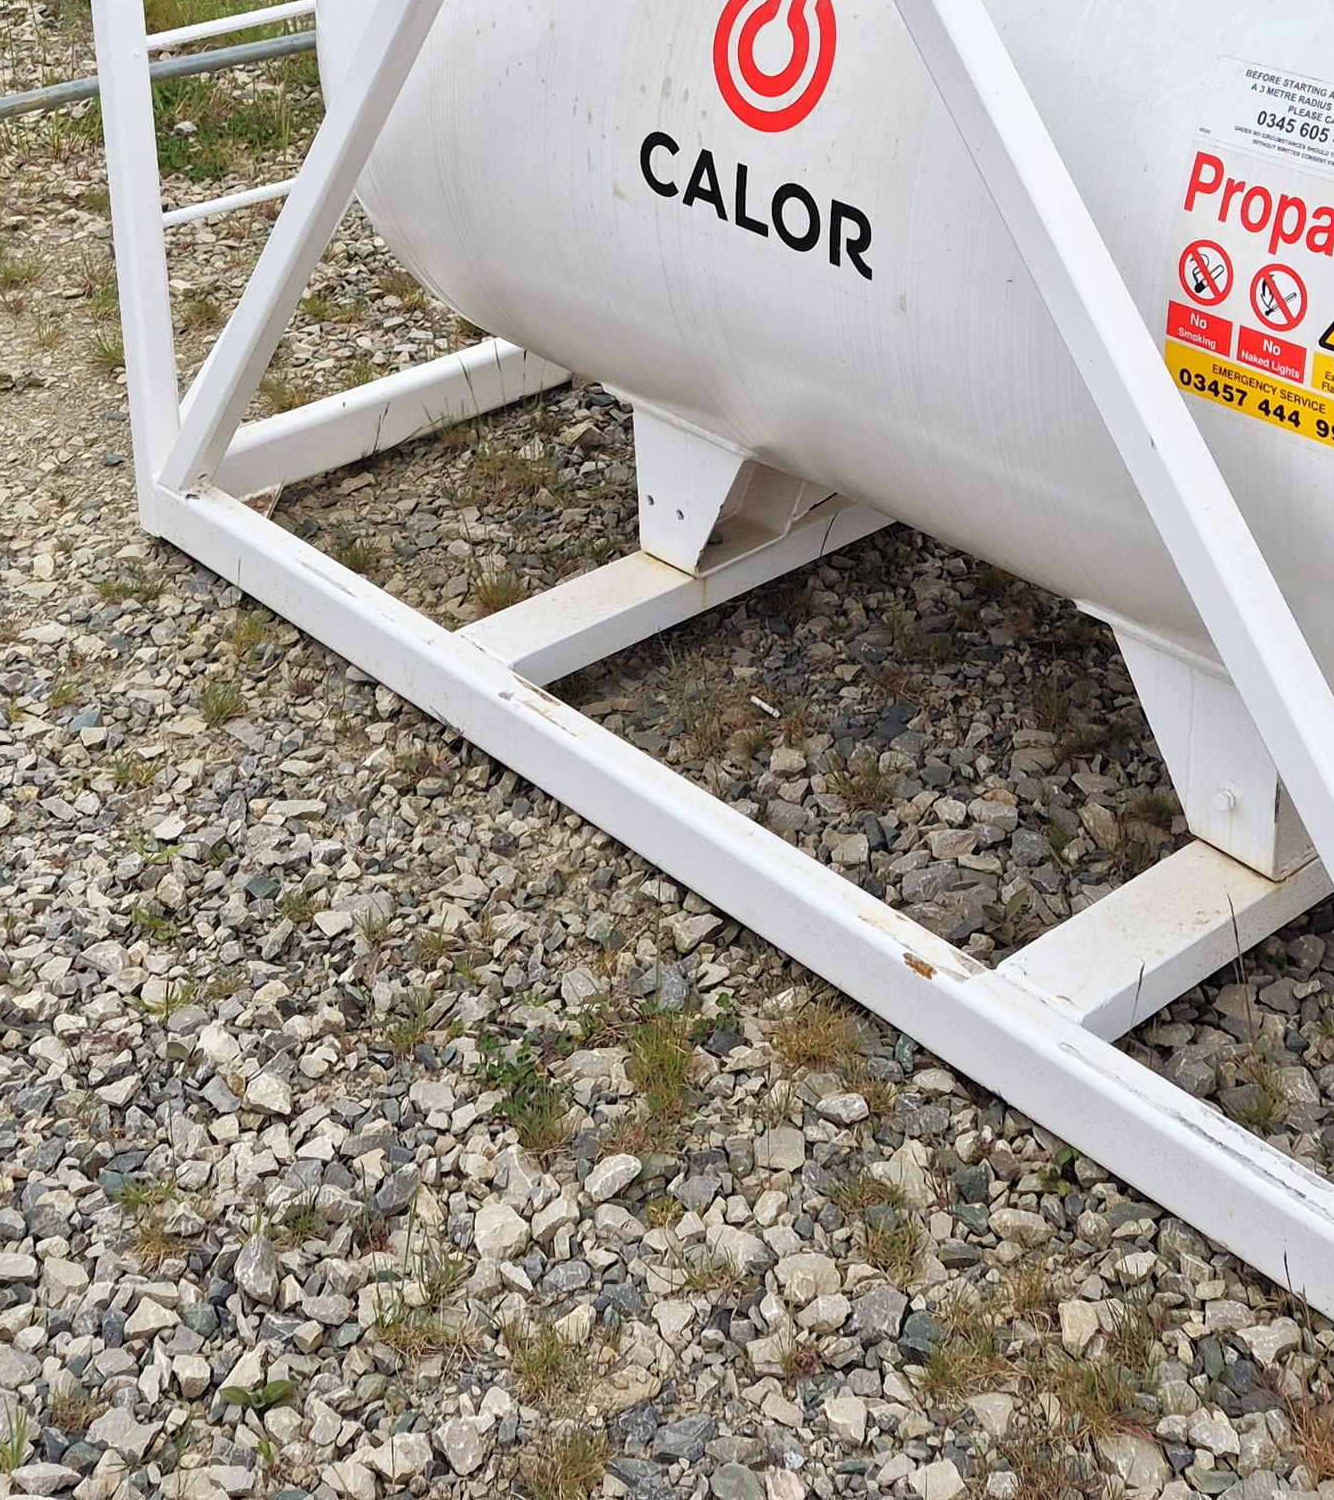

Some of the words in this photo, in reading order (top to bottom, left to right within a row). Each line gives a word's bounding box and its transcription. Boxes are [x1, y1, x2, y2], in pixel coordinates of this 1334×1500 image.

[1245, 69, 1282, 85] BEFORE
[1283, 79, 1327, 97] STARTING
[1250, 83, 1257, 91] A
[1259, 85, 1265, 93] 3
[1266, 86, 1297, 102] METRE
[1298, 95, 1332, 111] RADIUS
[1256, 110, 1297, 134] 0345
[1299, 122, 1330, 143] 605
[1287, 105, 1323, 122] PLEASE
[640, 131, 872, 281] CALOR
[1189, 313, 1207, 330] No
[1178, 327, 1216, 351] Smoking
[1262, 338, 1281, 356] No
[1241, 350, 1270, 370] Naked
[1271, 360, 1300, 380] Lights
[1179, 368, 1248, 407] 03457
[1258, 399, 1301, 428] 444
[1212, 363, 1277, 396] EMERGENCY
[1279, 389, 1326, 415] SERVICE
